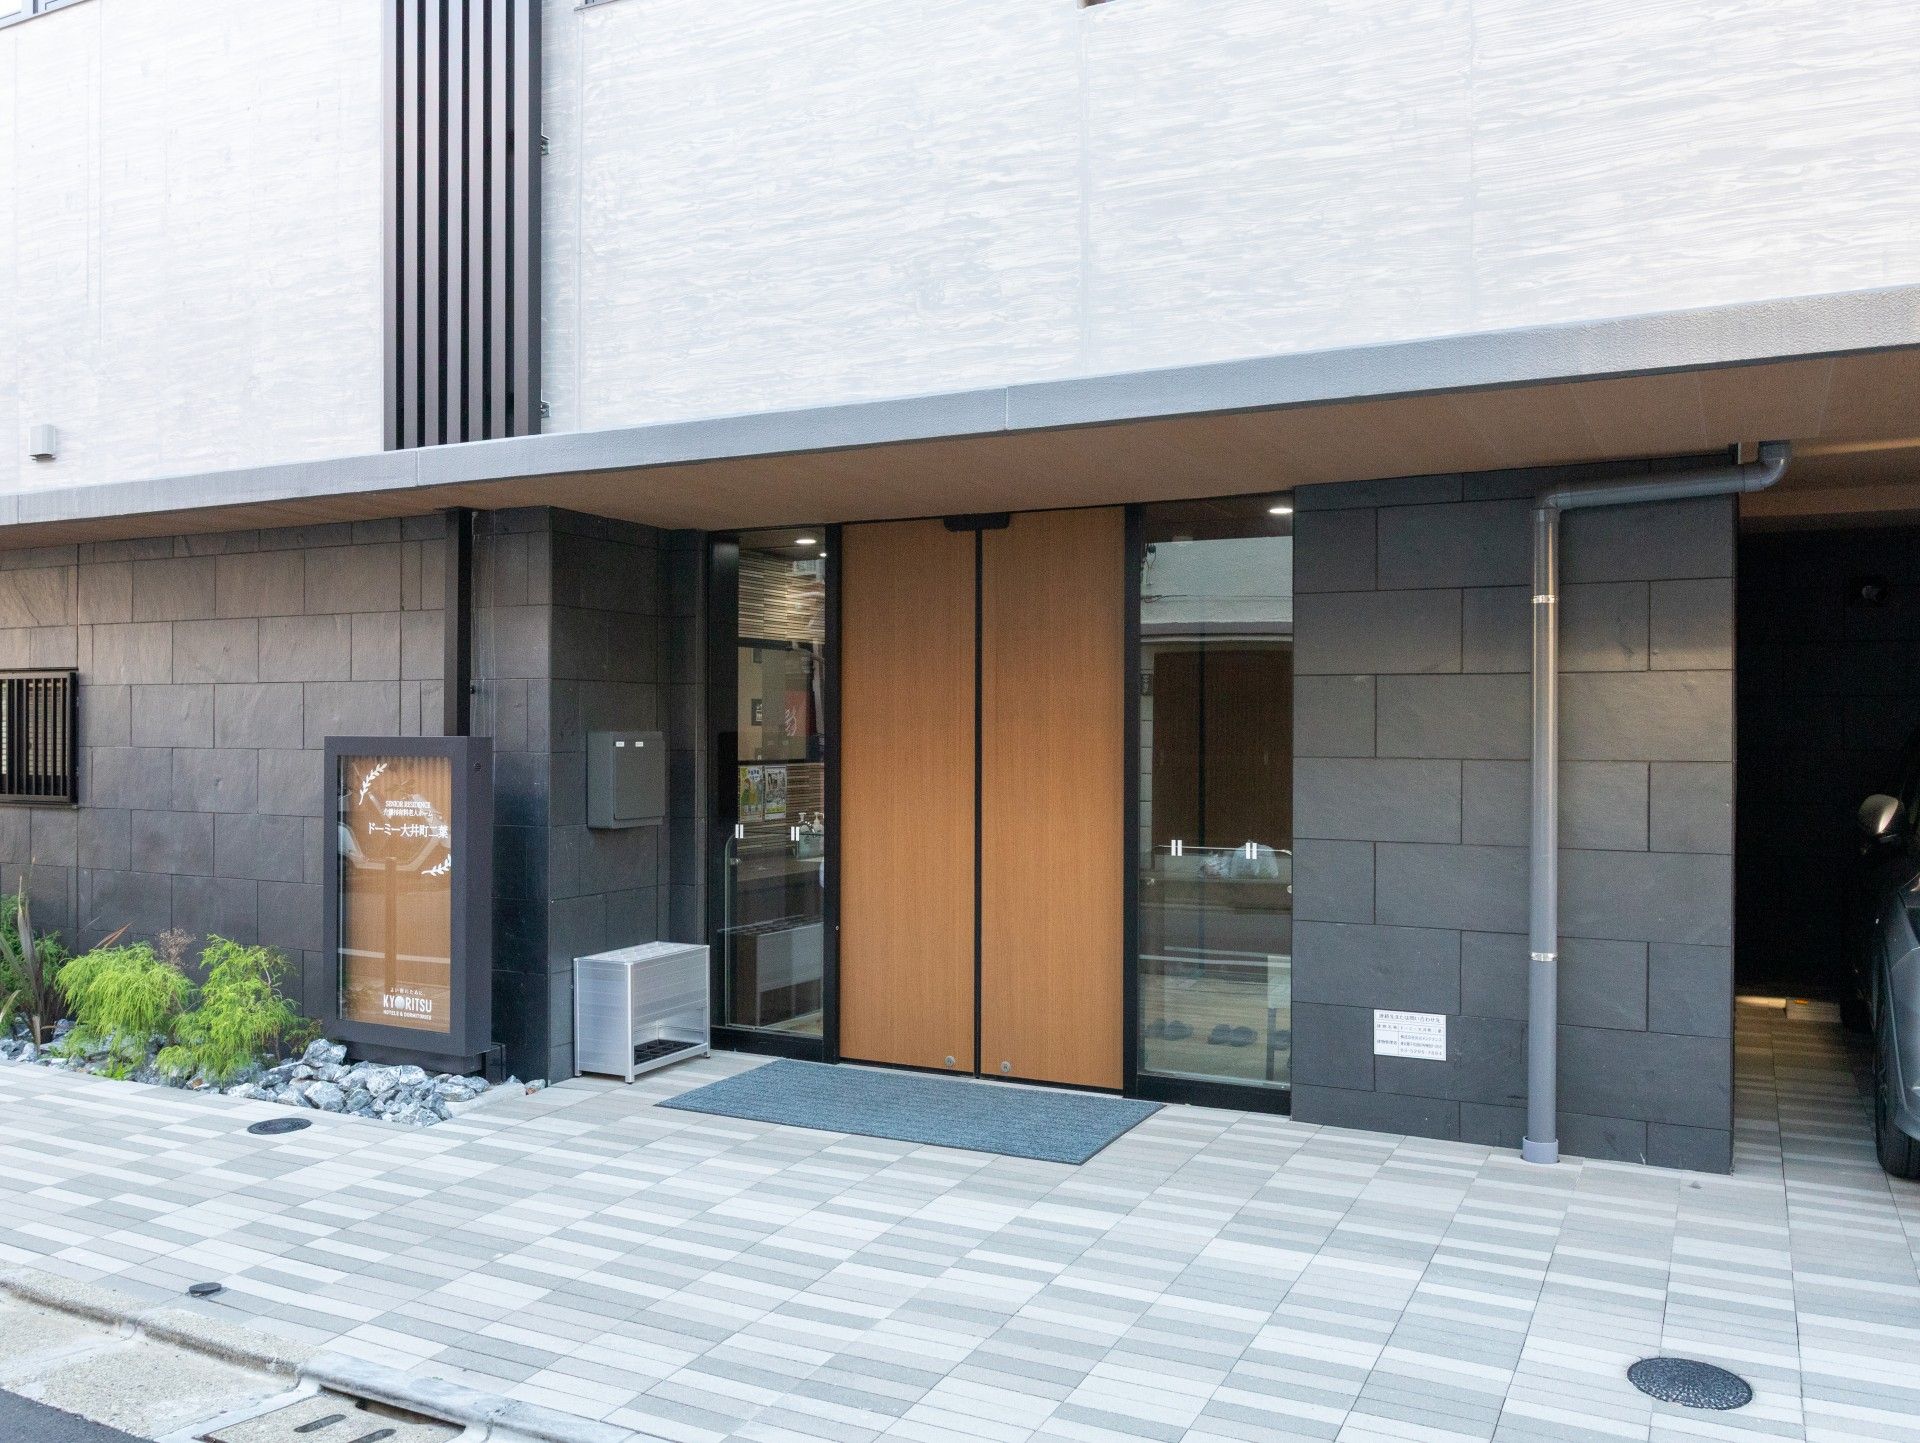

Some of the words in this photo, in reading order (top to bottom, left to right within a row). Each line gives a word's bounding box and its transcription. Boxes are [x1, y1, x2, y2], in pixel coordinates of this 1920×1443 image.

[368, 822, 448, 838] ドーミー大井町二葉
